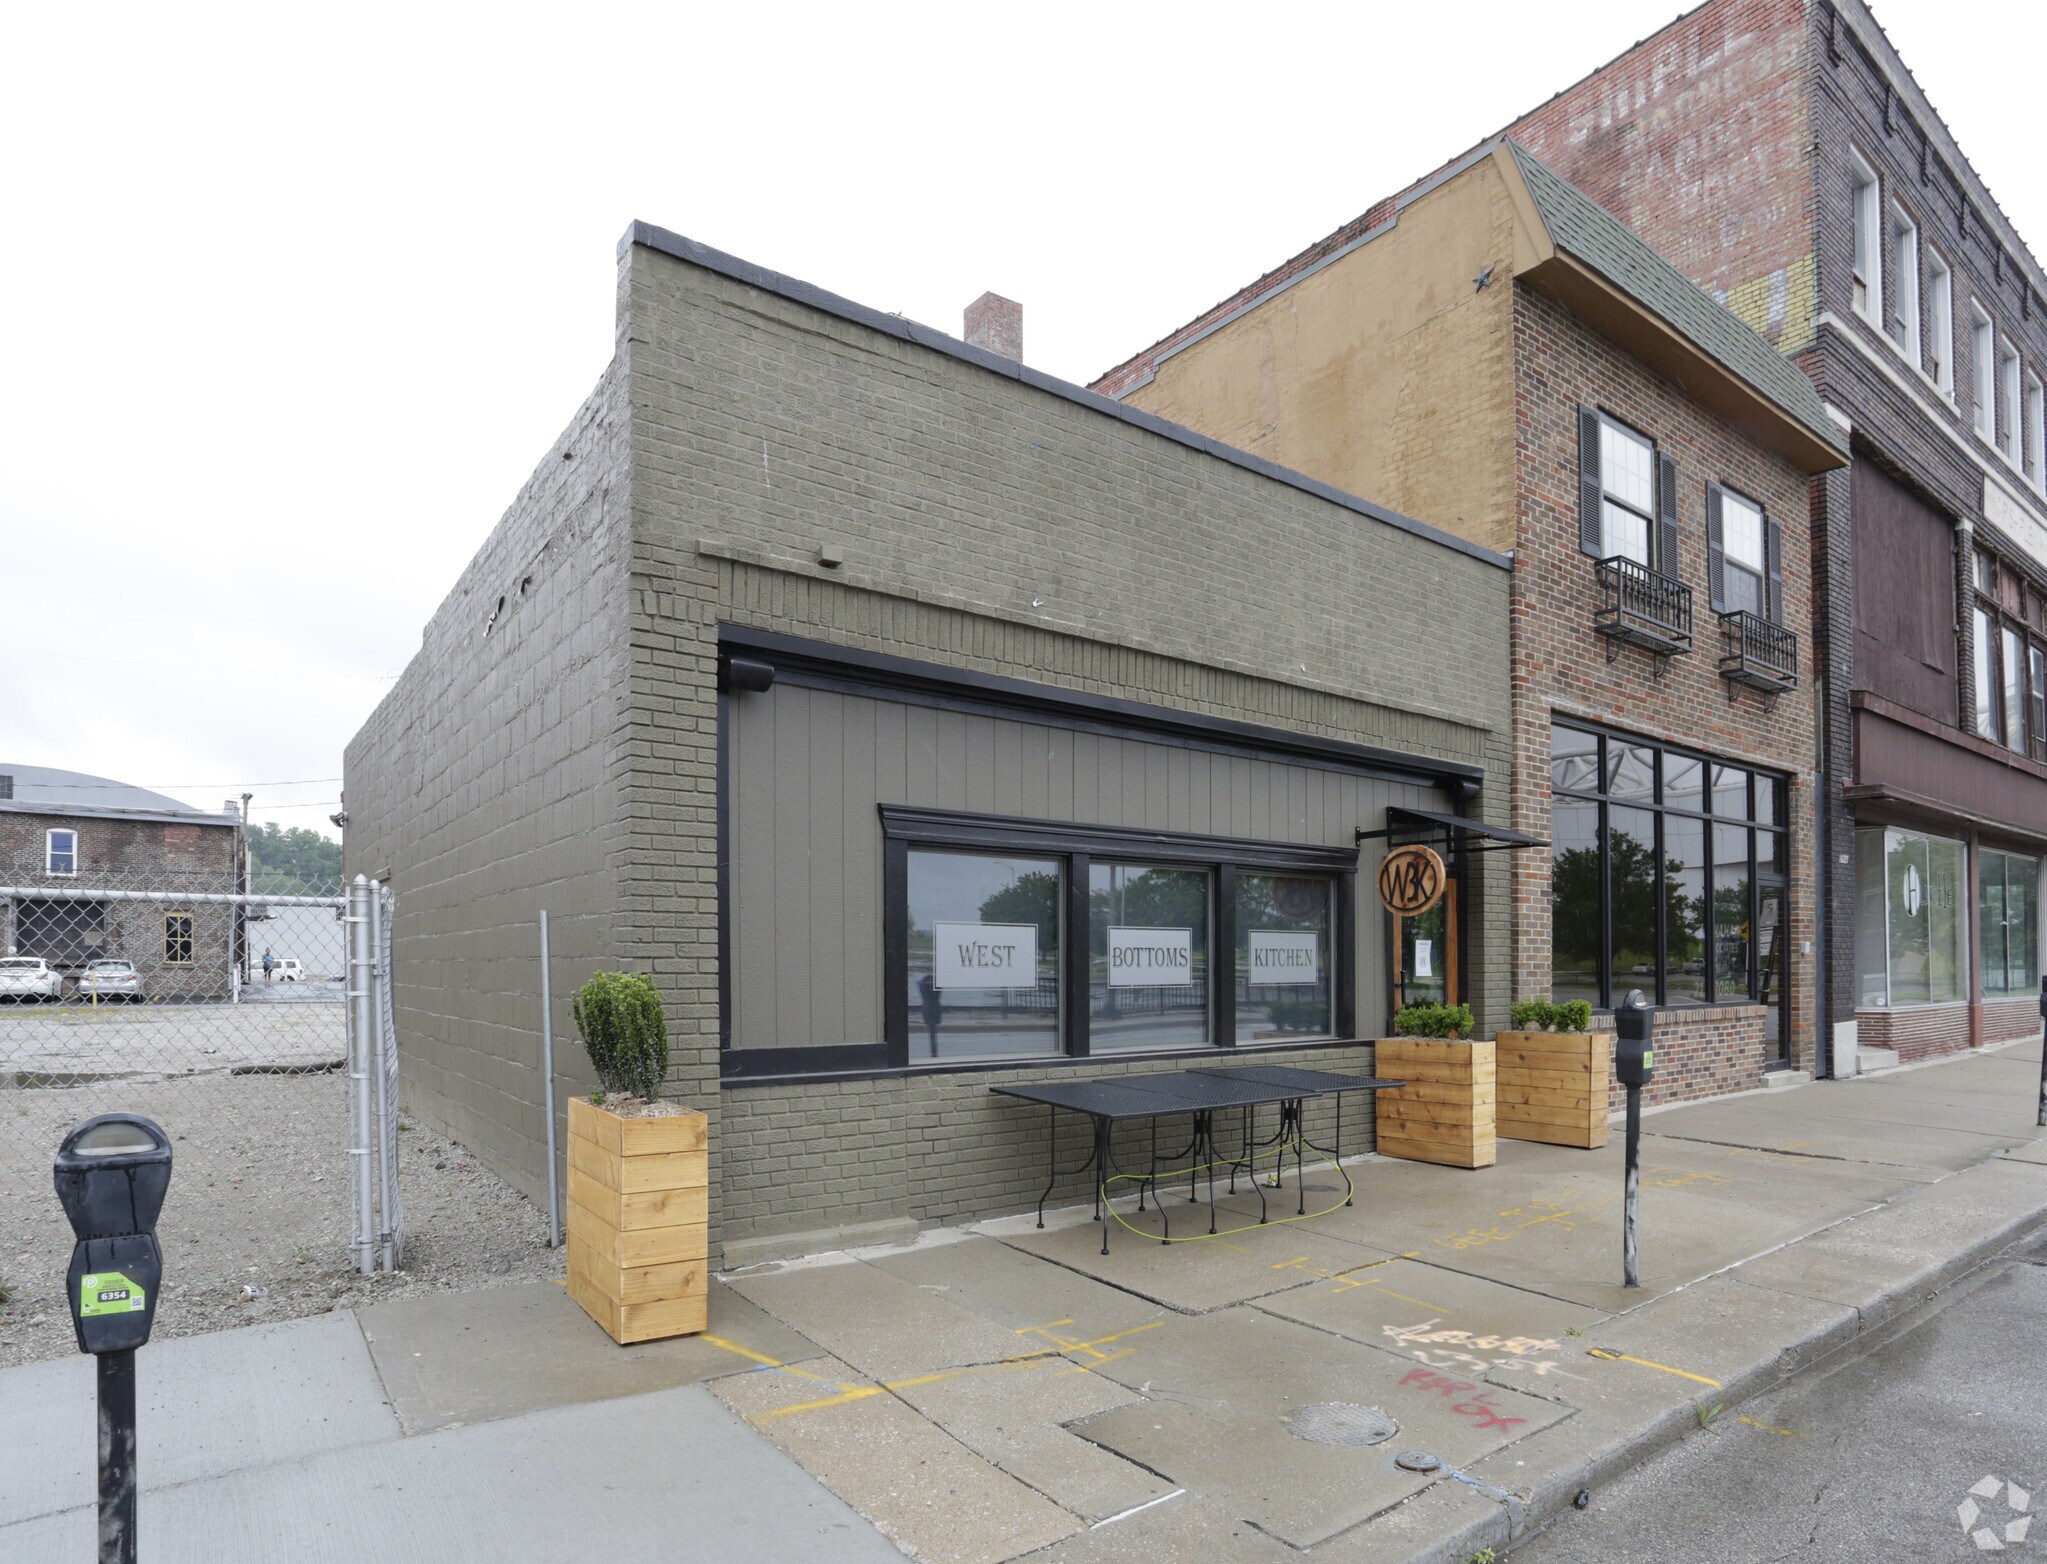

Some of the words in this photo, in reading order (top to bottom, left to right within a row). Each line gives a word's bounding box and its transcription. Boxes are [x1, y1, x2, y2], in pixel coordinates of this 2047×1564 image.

[1384, 861, 1431, 905] WBK
[958, 940, 1016, 968] WEST
[1112, 946, 1188, 967] BOTTOMS
[1254, 948, 1312, 967] KITCHEN
[101, 1291, 127, 1300] 6354
